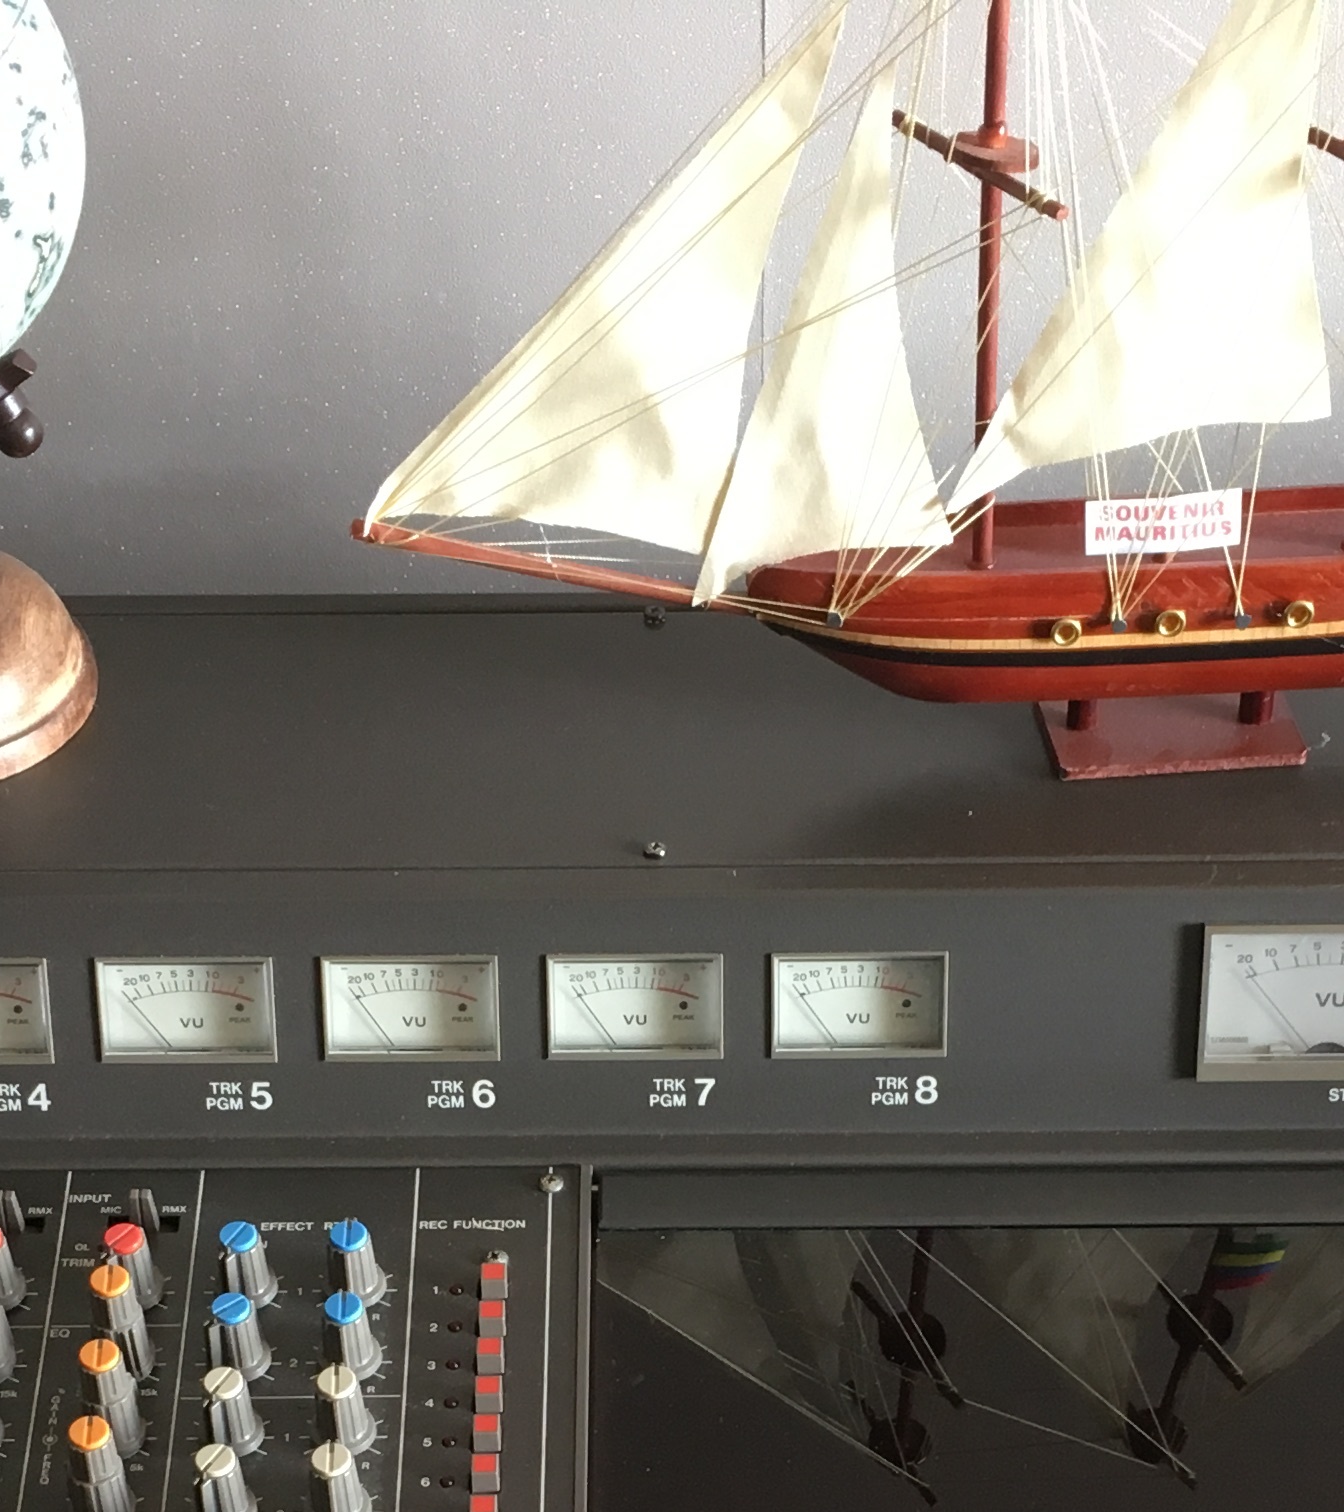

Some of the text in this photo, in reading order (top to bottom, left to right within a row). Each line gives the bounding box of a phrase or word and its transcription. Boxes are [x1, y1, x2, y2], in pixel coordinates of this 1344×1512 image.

[1099, 503, 1224, 521] SOUVENIR
[1095, 521, 1232, 541] MAURITIUS
[180, 1018, 204, 1028] VU
[403, 1016, 426, 1027] VU
[624, 1015, 647, 1025] VU
[847, 1013, 870, 1024] VU
[209, 1082, 242, 1094] TRK
[431, 1081, 464, 1096] TRK
[653, 1079, 685, 1091] TRK
[876, 1077, 908, 1089] TRK
[250, 1082, 272, 1110] 5
[472, 1080, 495, 1108] 6
[695, 1079, 715, 1105] 7
[915, 1076, 938, 1104] 8
[28, 1084, 51, 1111] 4
[206, 1097, 243, 1110] PGM
[428, 1095, 464, 1108] PGM
[650, 1094, 686, 1107] PGM
[872, 1092, 908, 1105] PGM
[69, 1194, 111, 1204] INPUT
[261, 1222, 314, 1231] EFFECT
[419, 1219, 526, 1230] REC FUNCTION
